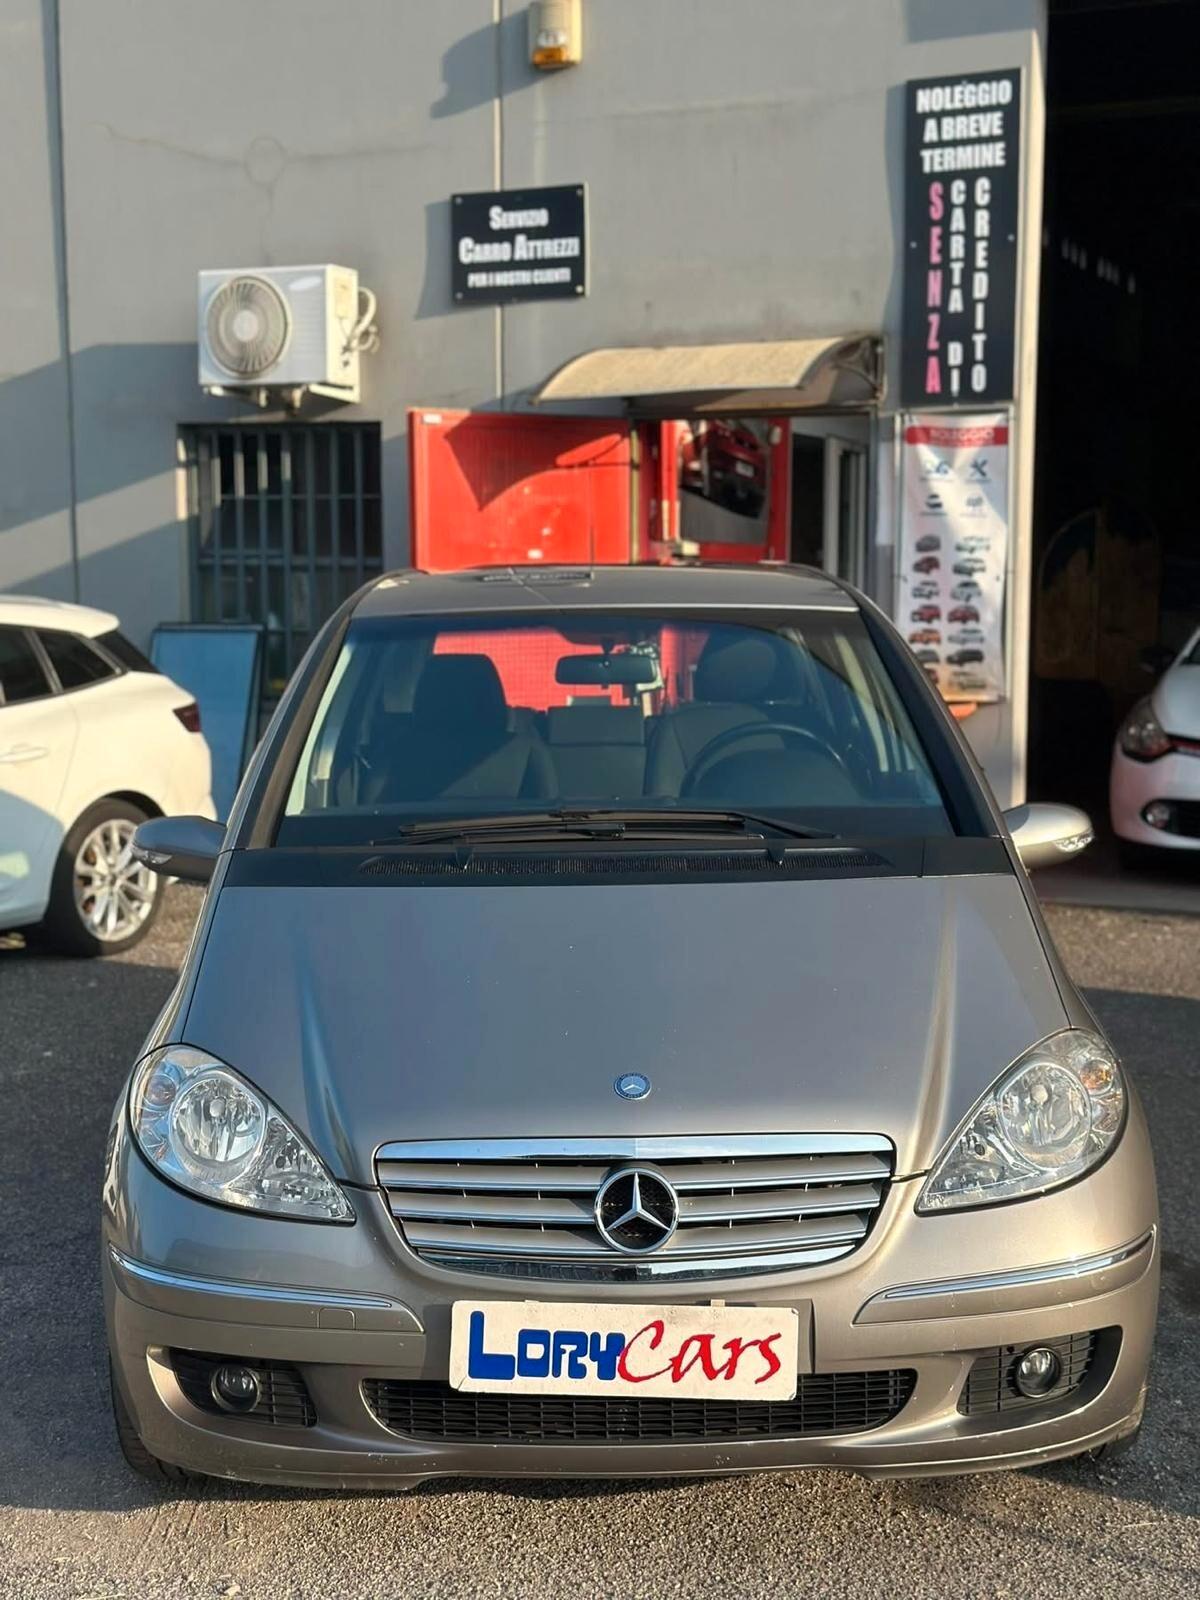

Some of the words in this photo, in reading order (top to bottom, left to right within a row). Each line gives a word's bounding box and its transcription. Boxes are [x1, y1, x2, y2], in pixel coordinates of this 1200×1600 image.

[916, 80, 1012, 113] NOLEGGIO
[923, 118, 939, 143] A
[942, 112, 1003, 140] BREVE
[920, 141, 1006, 173] TERMINE
[459, 237, 512, 264] CARRO
[513, 233, 580, 260] ATTREZZI
[948, 179, 966, 313] CARTA
[926, 181, 943, 394] SENZA
[971, 177, 991, 393] CREDITO
